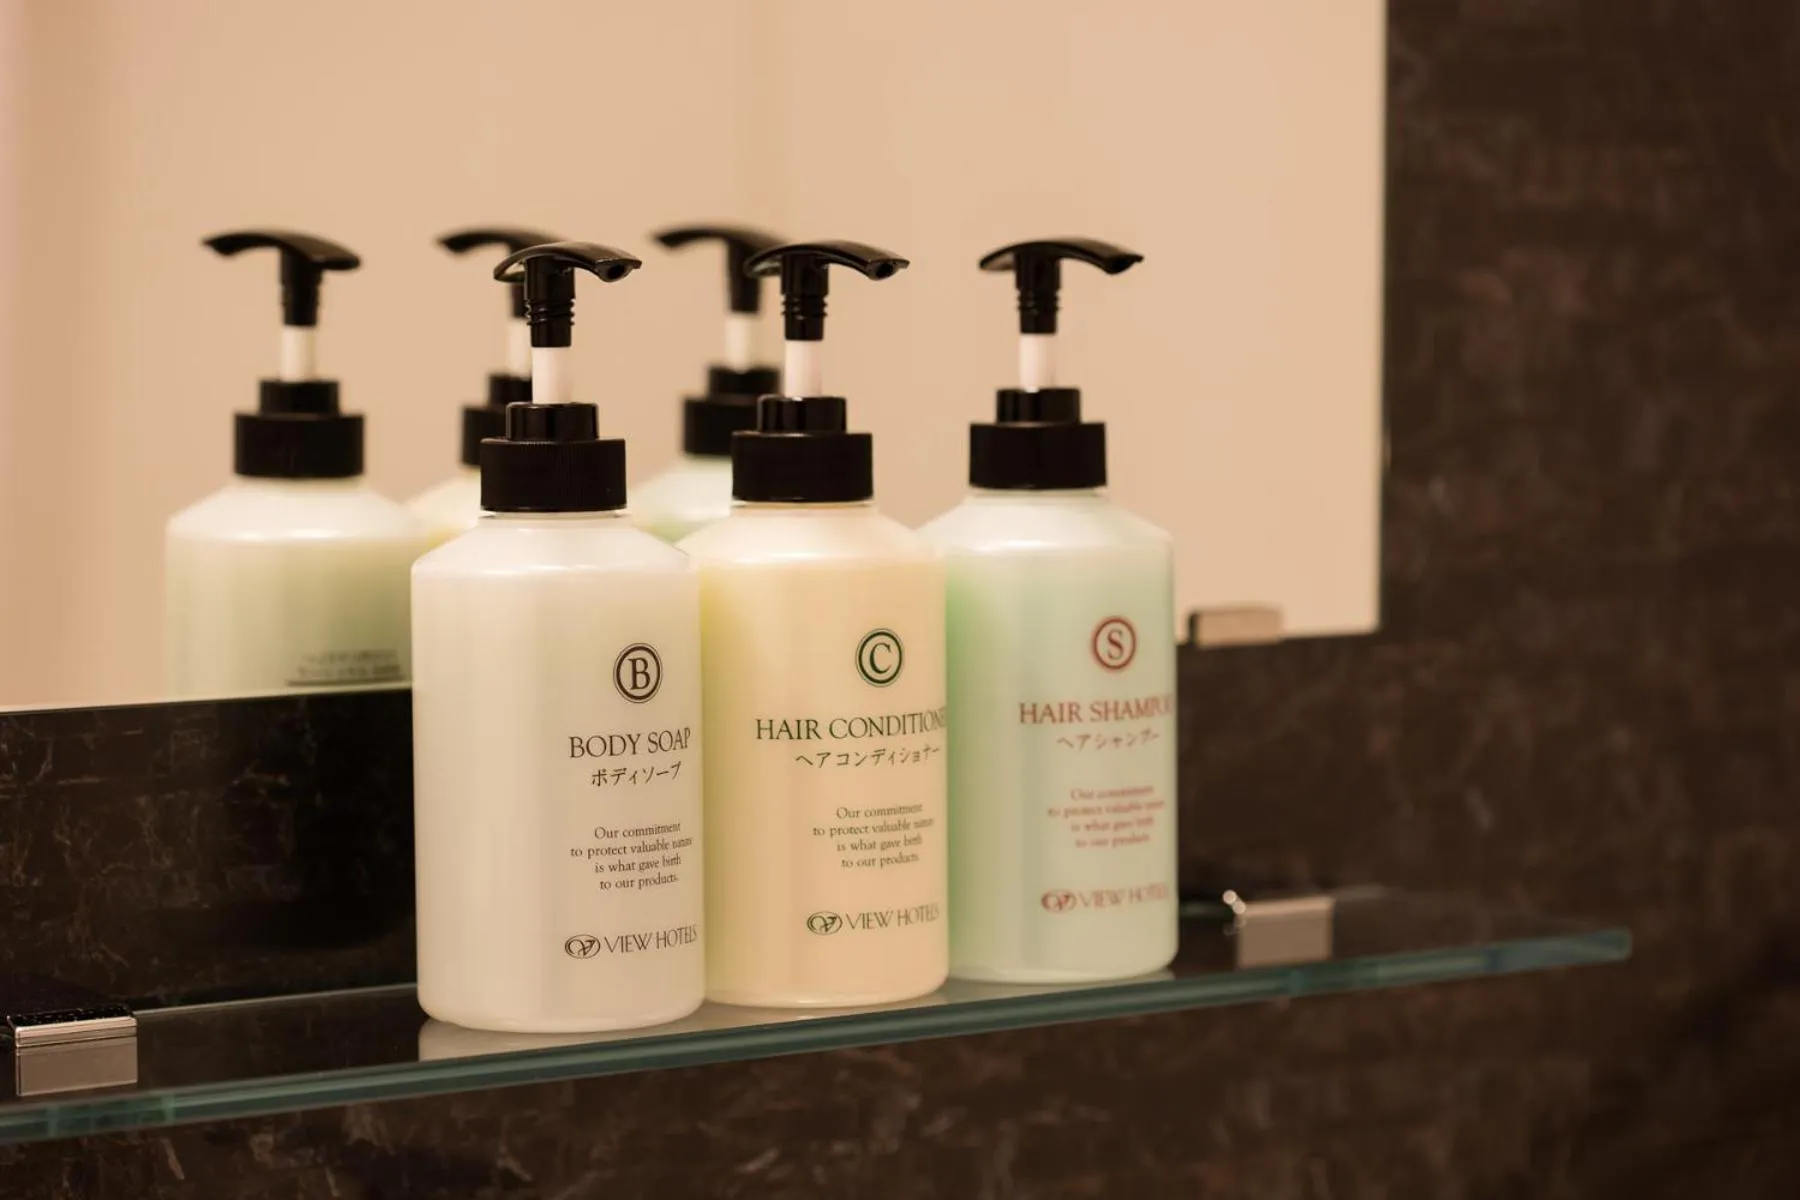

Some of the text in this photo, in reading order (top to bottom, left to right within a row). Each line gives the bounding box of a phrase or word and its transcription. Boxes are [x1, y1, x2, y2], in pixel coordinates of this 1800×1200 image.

[1019, 702, 1083, 725] HAIR
[755, 718, 822, 740] HAIR
[568, 726, 691, 759] BODY SOAP
[795, 745, 941, 769] ヘアコンディショナー
[836, 806, 861, 819] Our
[594, 822, 682, 839] Our commitment
[813, 827, 826, 836] to
[828, 823, 869, 838] protect
[570, 848, 583, 857] to
[587, 845, 628, 859] protect
[630, 838, 670, 855] valuable
[850, 838, 877, 851] what
[595, 862, 605, 873] is
[608, 859, 636, 873] what
[638, 860, 660, 872] gave
[841, 859, 854, 868] to
[856, 859, 876, 868] our
[599, 880, 612, 890] to
[615, 879, 635, 890] our
[845, 910, 894, 930] VIEW
[603, 923, 698, 954] VIEW HOTELS
